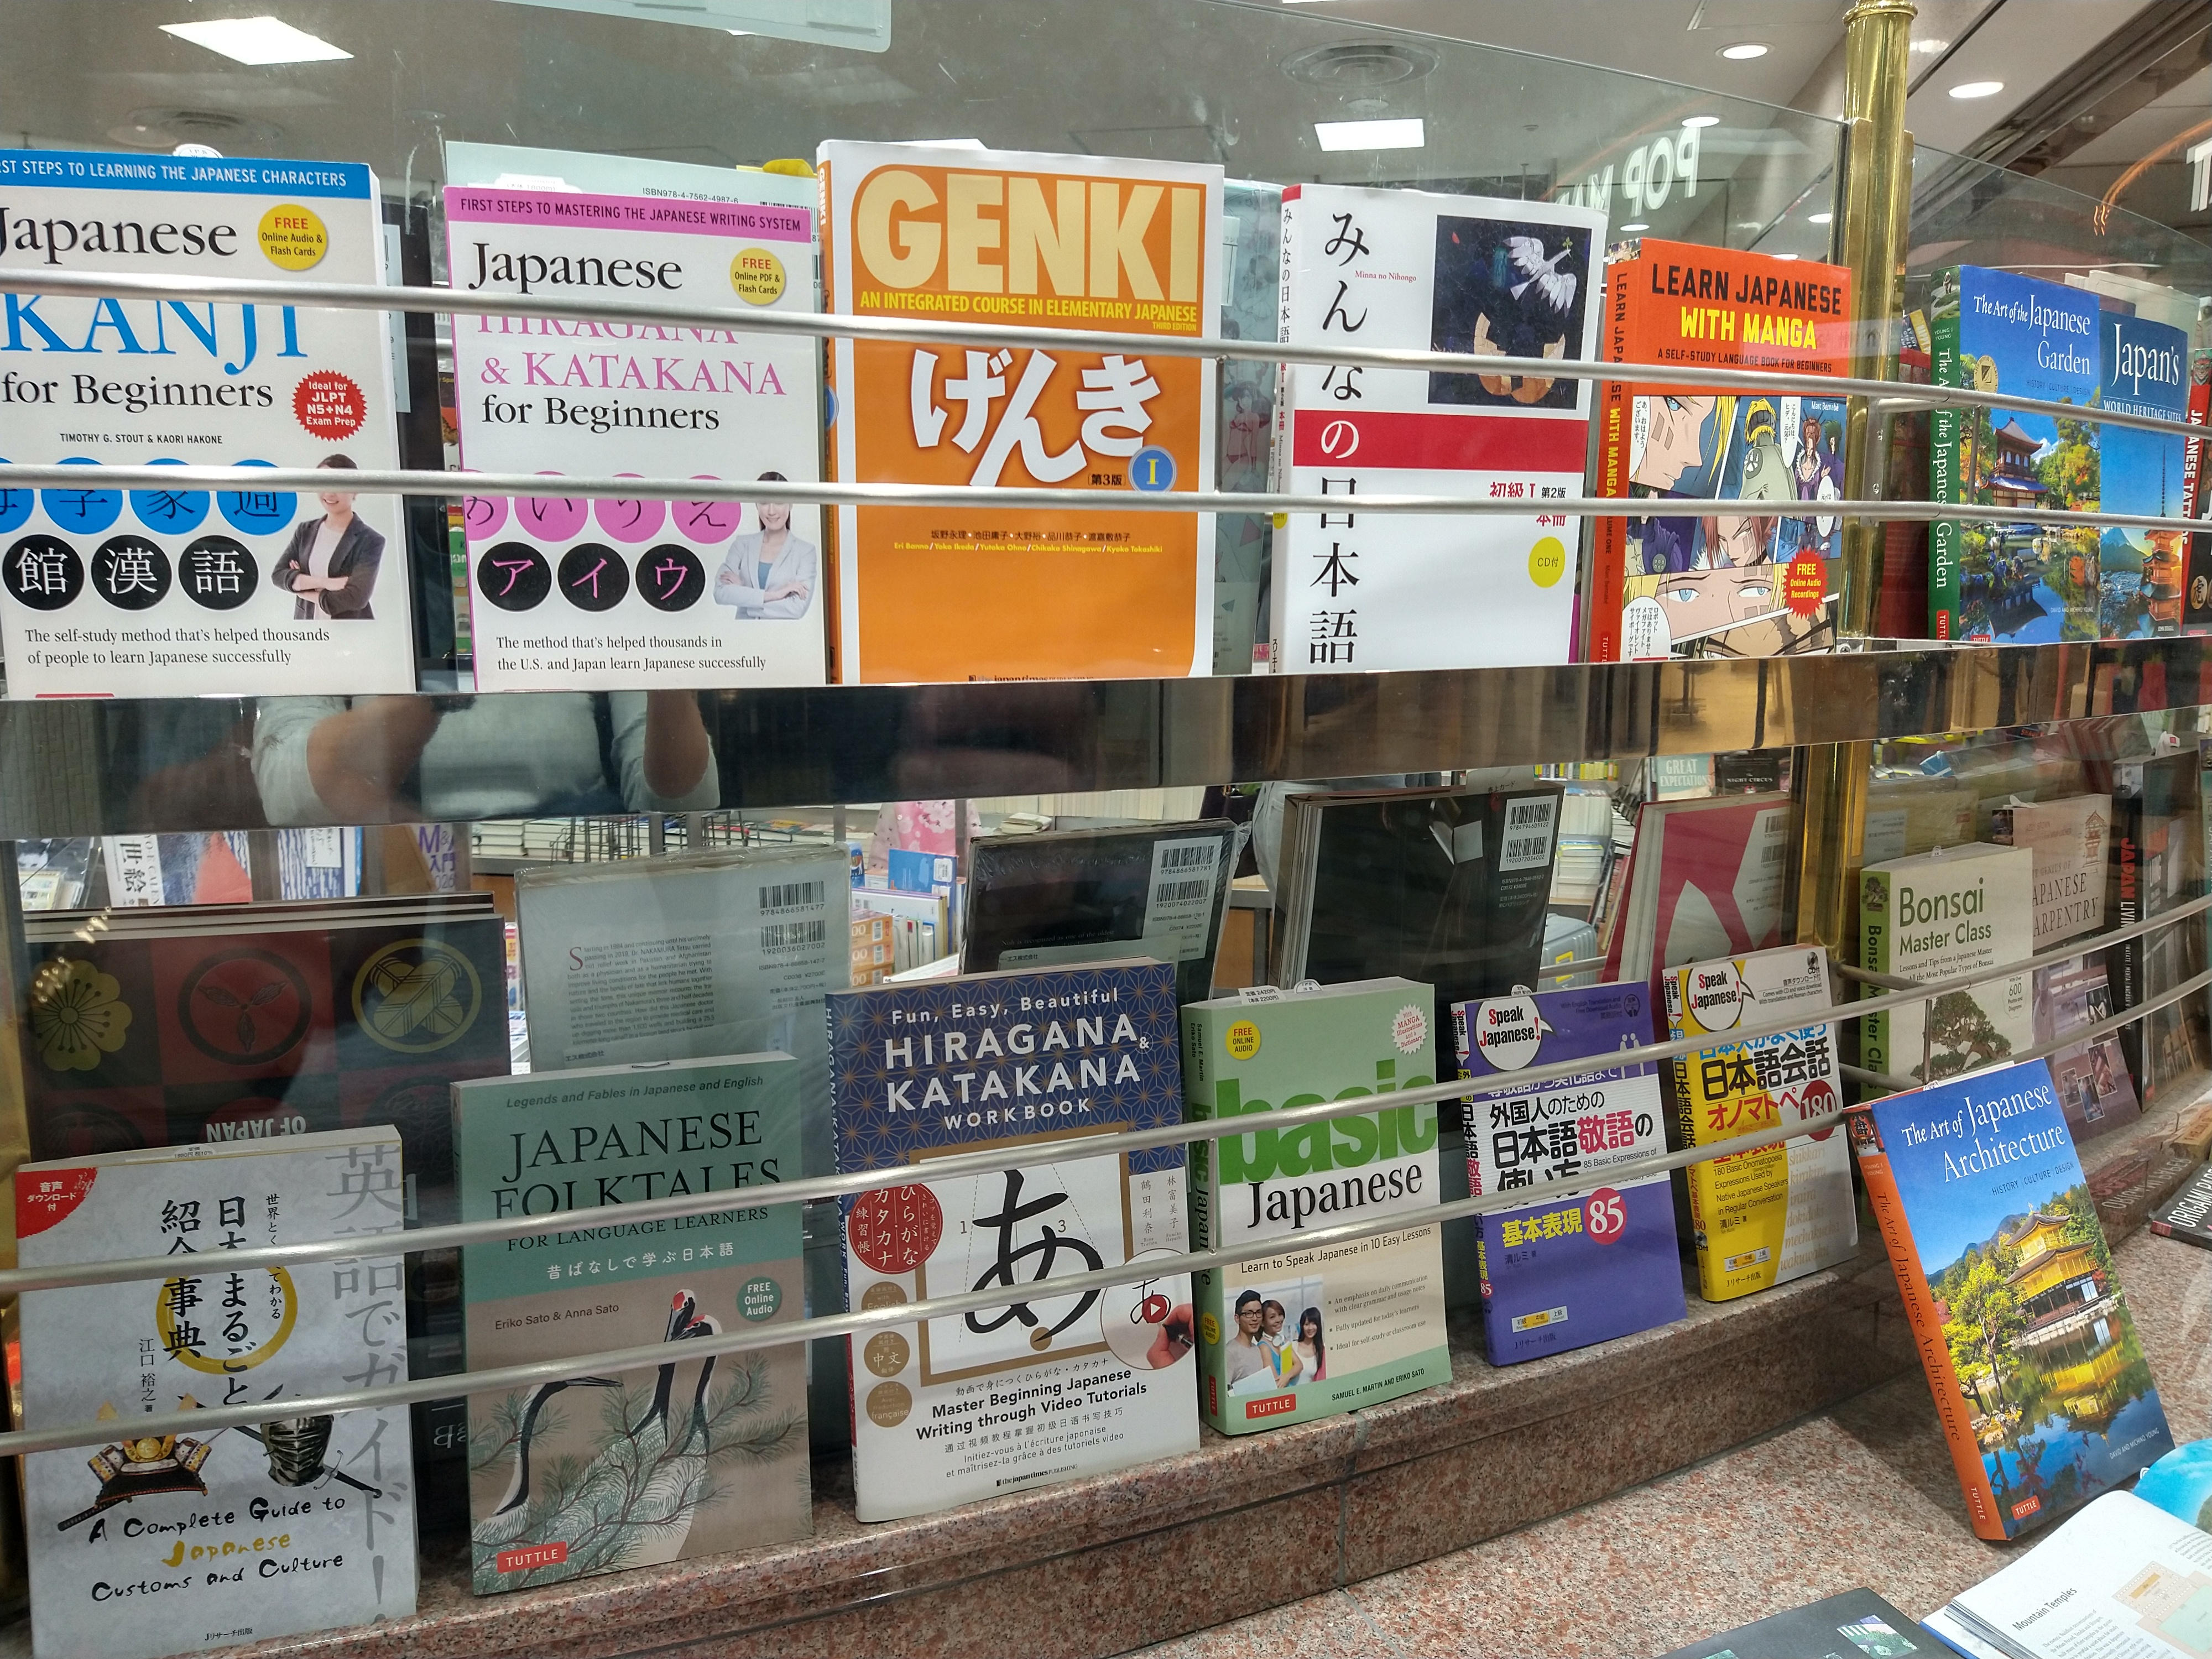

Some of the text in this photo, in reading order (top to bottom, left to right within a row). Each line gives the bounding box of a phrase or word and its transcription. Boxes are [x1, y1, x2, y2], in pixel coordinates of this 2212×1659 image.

[23, 160, 63, 175] STEPS
[68, 163, 85, 176] TO
[90, 163, 156, 180] LEARNING
[162, 166, 187, 181] THE
[191, 167, 258, 184] JAPANESE
[262, 169, 346, 187] CHARACTERS
[643, 187, 739, 204] ISBN978-4-7562-4987-6
[0, 207, 238, 265] Japanese
[858, 169, 1201, 303] GENKI
[468, 242, 684, 295] Japanese
[1280, 208, 1292, 343] みんなの日本語
[1355, 270, 1376, 280] Minna
[1389, 272, 1417, 283] Nihongo
[860, 291, 1197, 322] AN INTEGRATED COURSE IN ELEMENTARY JAPANESE
[1652, 263, 1841, 315] LEARN JAPANESE
[1152, 321, 1197, 331] THIRD EDITION
[1681, 306, 1817, 349] WITH MANGA
[1973, 294, 2090, 337] The Art of the Japanese
[0, 293, 309, 375] KANJI
[480, 351, 787, 395] & KATAKANA
[1657, 349, 1832, 373] A SELF-STUDY LANGUAGE BOOK FOR BEGINNERS
[2037, 341, 2090, 375] Garden
[2111, 323, 2179, 395] Japan's
[2, 371, 274, 414] for Beginners
[1811, 401, 1821, 410] Marc
[2104, 400, 2131, 414] WORLD
[2133, 404, 2164, 419] HERITAGE
[482, 394, 720, 434] for Beginners
[912, 347, 1161, 487] げんき
[1541, 487, 1567, 499] 第2版
[1537, 557, 1558, 568] CD付
[1797, 564, 1817, 576] FREE
[1936, 523, 1952, 588] Garden
[1790, 577, 1822, 587] Online Audio
[1791, 589, 1819, 599] Recordings
[1660, 775, 1712, 787] EXPECTATIONS
[1666, 759, 1697, 774] GREAT
[1510, 822, 1549, 831] 9784794605122
[1160, 865, 1212, 875] 9784866581781
[1506, 854, 1545, 864] 1920072034002
[2121, 838, 2135, 898] JAPAN
[760, 903, 825, 916] 9784866581477
[1156, 899, 1207, 909] 1920074022007
[1900, 877, 1984, 927] Bonsai
[761, 942, 826, 956] 1920036027002
[1900, 921, 1991, 956] Master Class
[892, 988, 1118, 1025] Fun, Easy, Beautiful
[2008, 982, 2022, 995] 600
[1479, 1017, 1541, 1047] Japanese!
[1489, 1006, 1524, 1025] Speak
[885, 1014, 1150, 1070] HIRAGANA &
[888, 1054, 1141, 1113] KATAKANA
[1700, 1037, 1830, 1101] 日本語会話
[506, 1076, 764, 1108] Legends and Fables in Japanese and English
[1490, 1091, 1605, 1129] 外国人のための
[206, 1115, 307, 1143] OF JAPAN
[945, 1098, 1091, 1130] WORKBOOK
[1215, 1058, 1438, 1185] basic
[1901, 1084, 2052, 1147] The Art of Japanese
[502, 1110, 762, 1183] JAPANESE
[1943, 1124, 2065, 1183] Architecture
[40, 1181, 62, 1192] 音声
[1248, 1165, 1422, 1229] Japanese
[1992, 1162, 2074, 1196] HISTORY CULTURE DESIGN
[27, 1192, 76, 1204] ダウンロード
[48, 1203, 56, 1213] 付
[1589, 1196, 1624, 1234] 85
[2167, 1189, 2204, 1228] ORIGAMI
[508, 1207, 769, 1251] FOR LANGUAGE LEARNERS
[1501, 1207, 1583, 1248] 基本表現
[547, 1242, 734, 1280] 昔ばなしで学ぶ日本語
[1241, 1226, 1431, 1274] Learn to Speak Japanese in 10 Easy Lessons
[916, 1383, 1147, 1441] Writing through Video Tutorials
[932, 1369, 1131, 1419] Master Beginning Japanese
[1252, 1399, 1290, 1414] TUTTLE
[88, 1496, 345, 1544] A Complete Guide to
[1971, 1487, 1986, 1520] TUTTLE
[2015, 1499, 2037, 1515] TUTTLE
[161, 1532, 291, 1568] Japanese
[505, 1549, 559, 1567] TUTTLE
[91, 1553, 343, 1601] Customs and Culture
[2012, 1587, 2077, 1631] Mountain Temples
